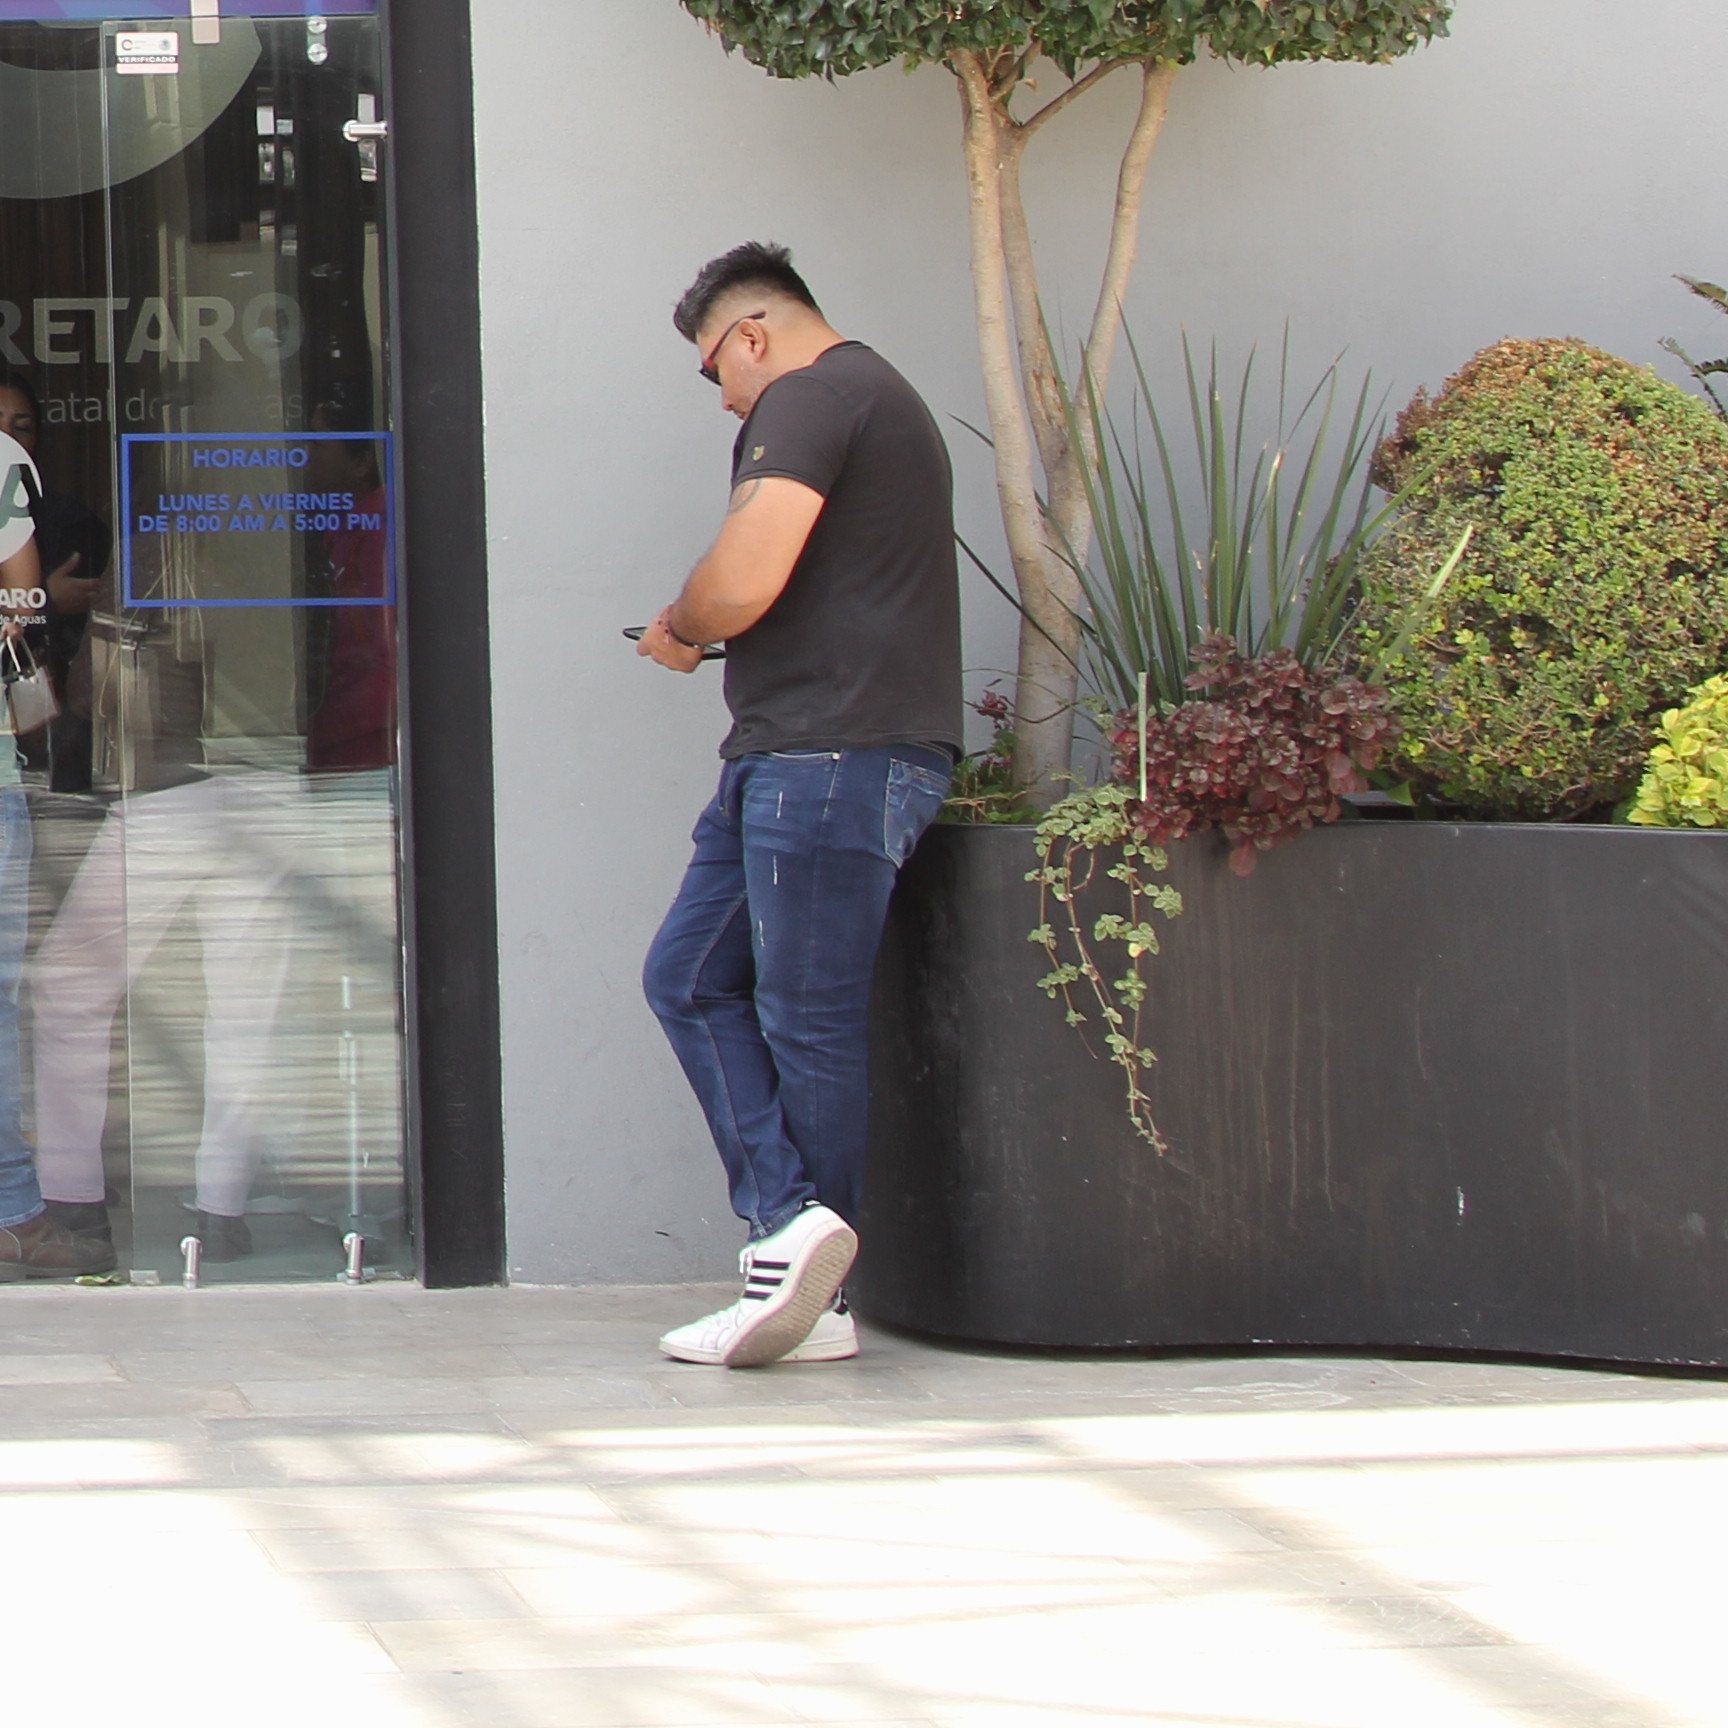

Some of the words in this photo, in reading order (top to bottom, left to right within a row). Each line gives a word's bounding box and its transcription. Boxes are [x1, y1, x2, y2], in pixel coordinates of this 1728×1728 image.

[191, 447, 309, 468] HORARIO
[158, 494, 230, 512] LUNES
[236, 494, 253, 511] A
[258, 492, 355, 511] VIERNES
[138, 515, 168, 533] DE
[176, 514, 221, 532] 8:00
[227, 514, 264, 531] AM
[271, 514, 289, 531] A
[294, 513, 340, 531] 5:00
[347, 512, 381, 531] PM
[13, 614, 47, 627] Aguas
